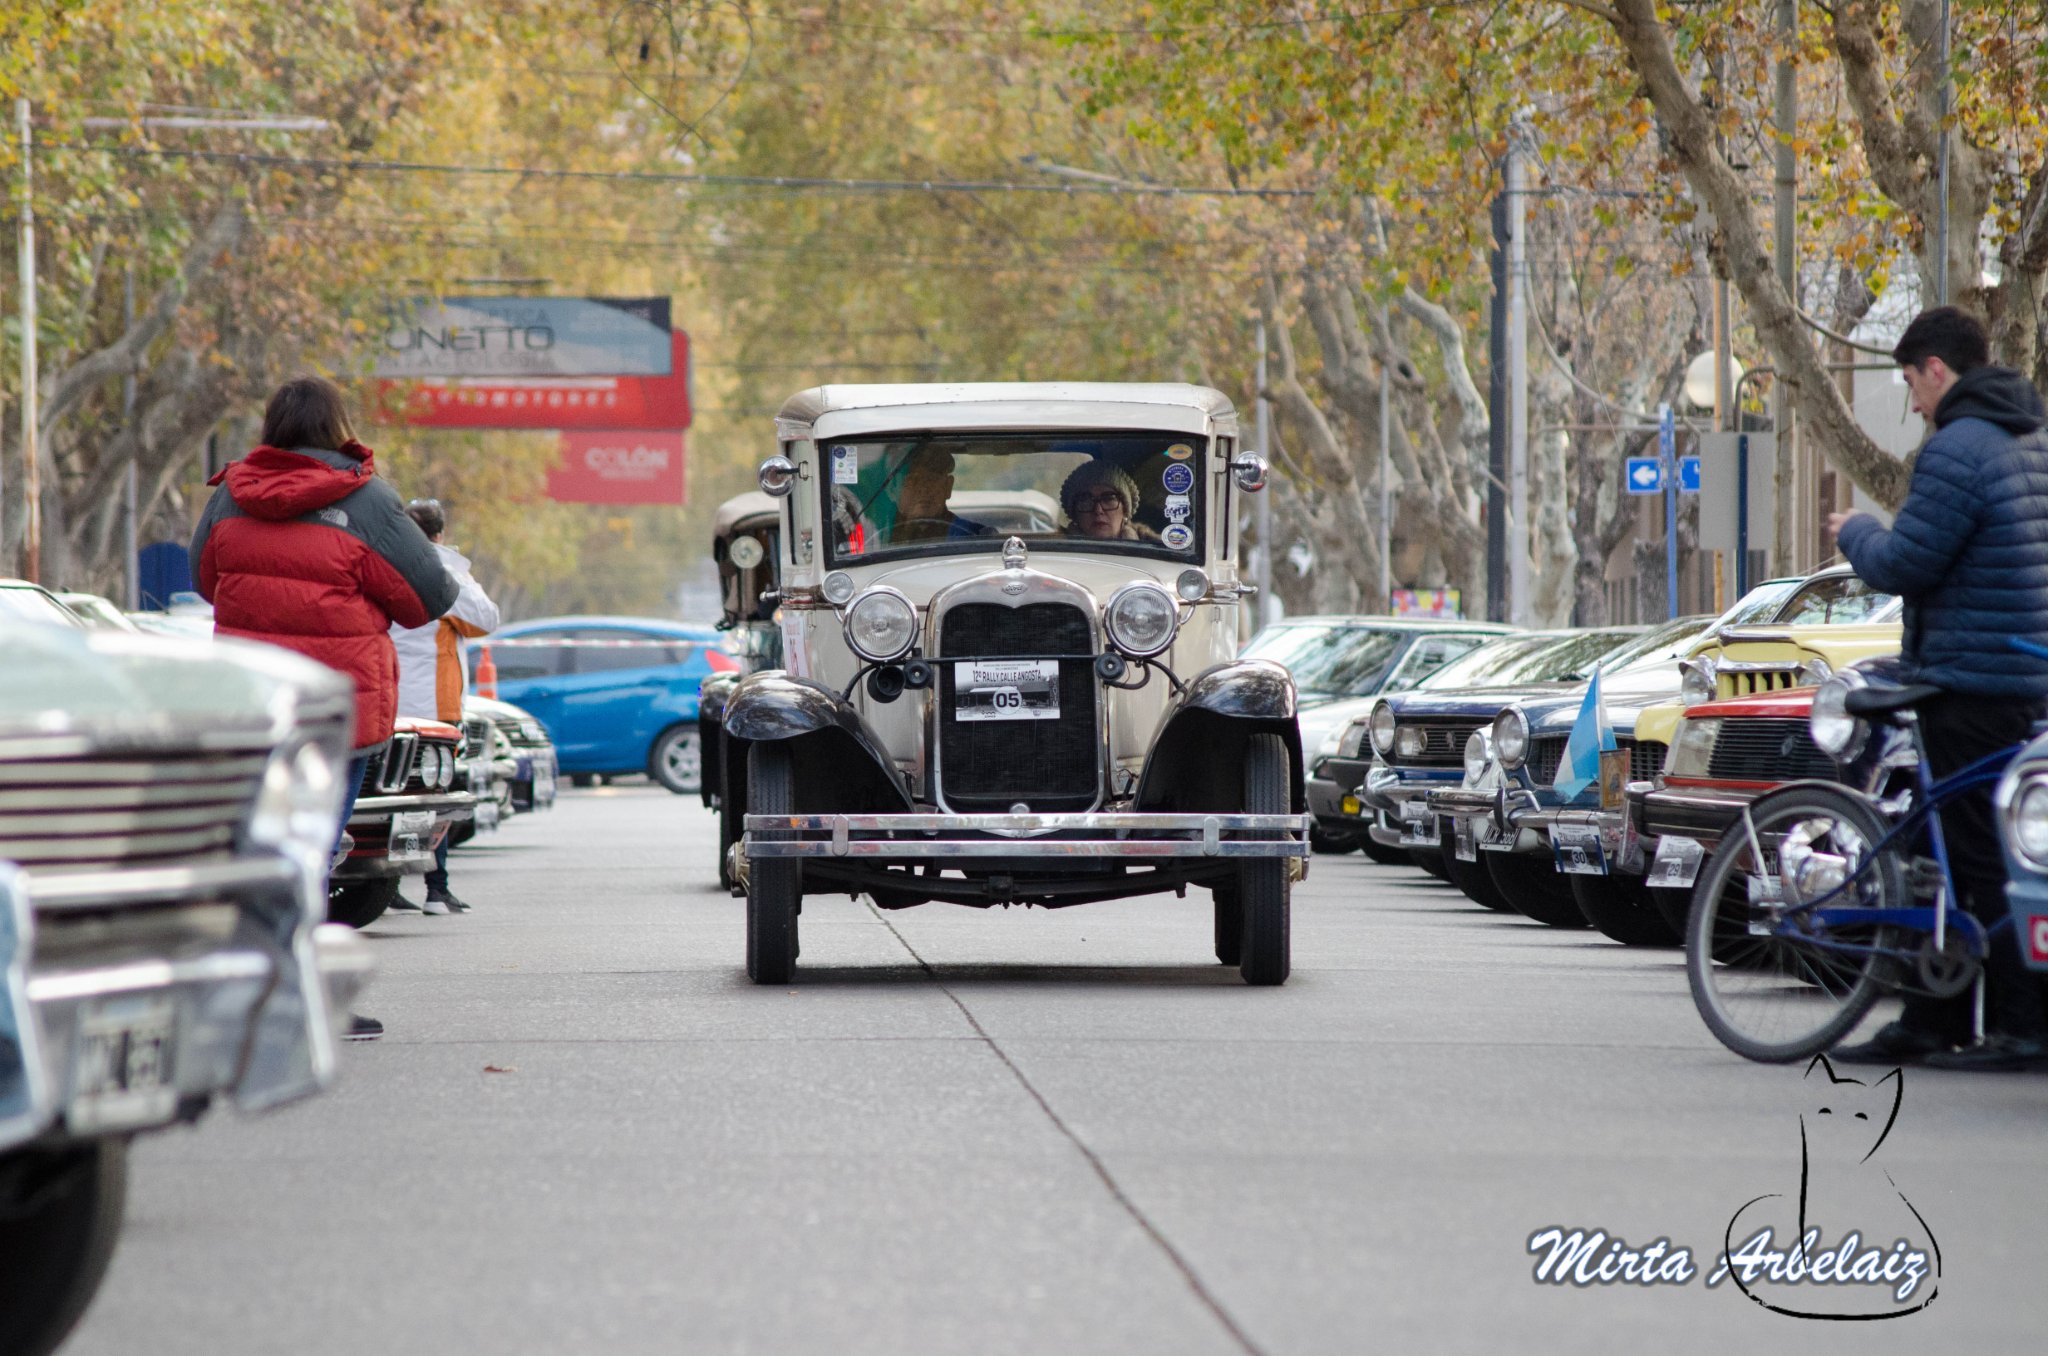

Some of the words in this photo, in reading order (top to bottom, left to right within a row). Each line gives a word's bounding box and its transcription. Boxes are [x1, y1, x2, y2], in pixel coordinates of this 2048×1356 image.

[983, 671, 1000, 683] RALLY
[1001, 671, 1017, 683] CALLE
[1018, 669, 1042, 682] ANGOSTA
[996, 693, 1020, 708] 05
[1414, 825, 1423, 836] 42
[1573, 852, 1586, 864] 30
[1667, 863, 1681, 877] 29
